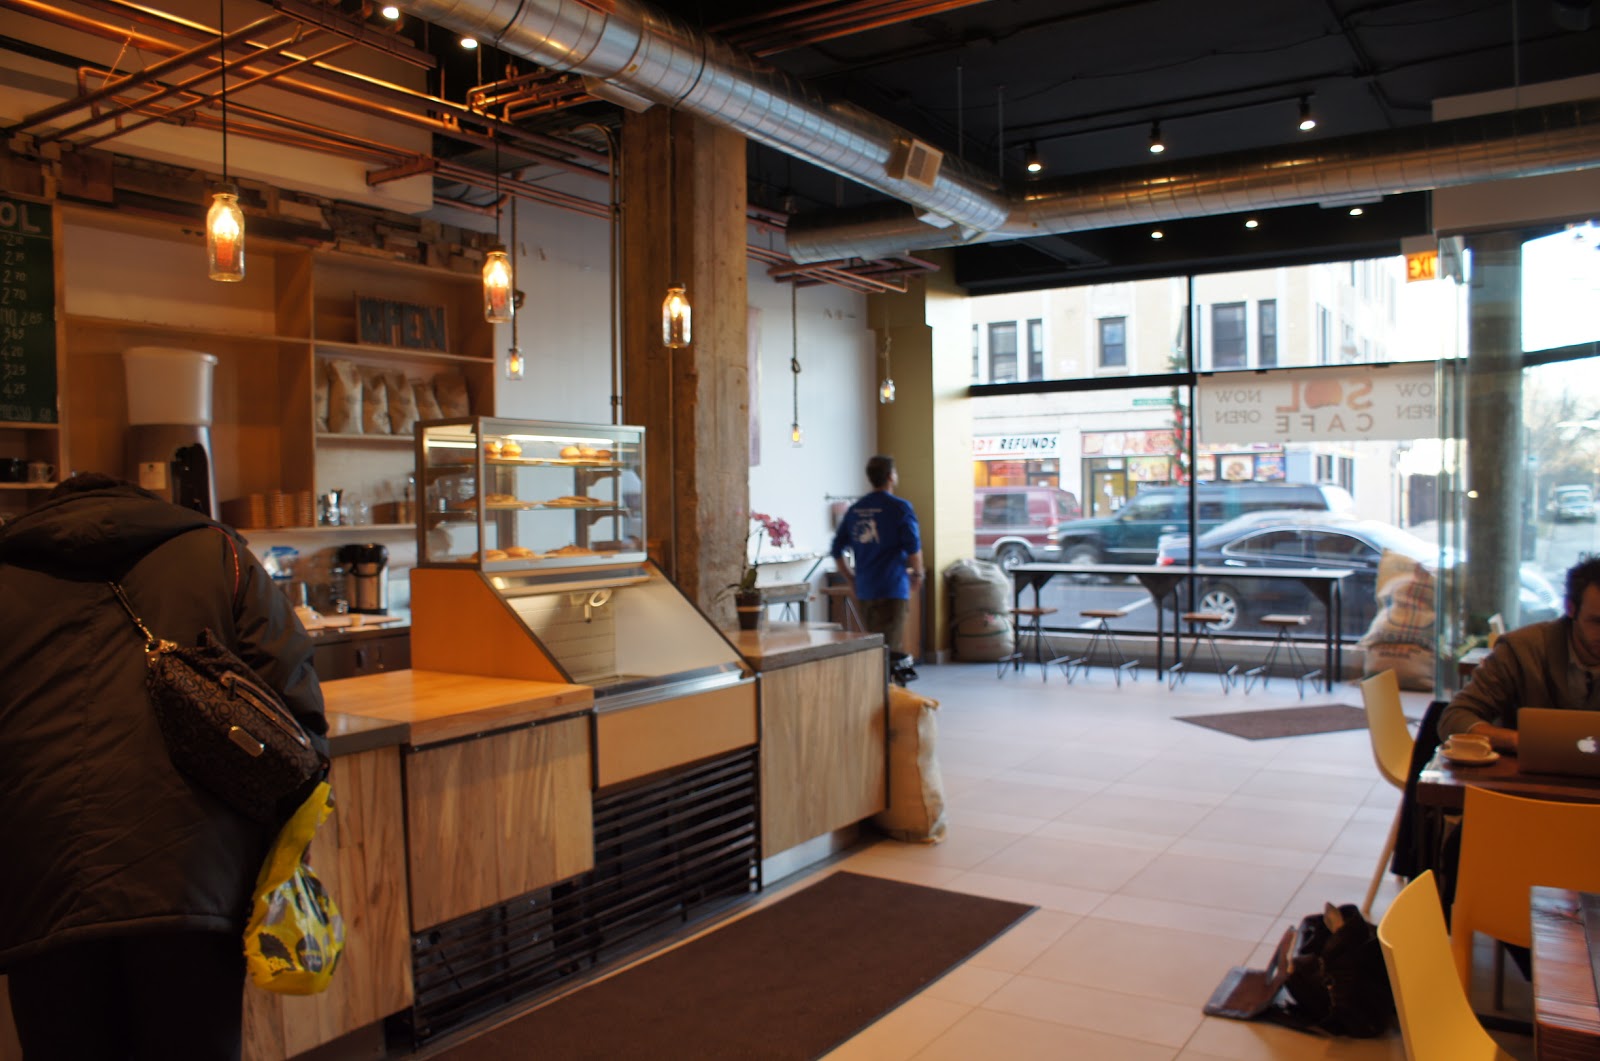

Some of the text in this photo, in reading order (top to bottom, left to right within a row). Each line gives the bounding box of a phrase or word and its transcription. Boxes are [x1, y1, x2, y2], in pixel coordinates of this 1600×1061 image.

[1407, 254, 1438, 279] EXI
[360, 298, 446, 350] OPEN
[999, 436, 1057, 450] REFUNDS
